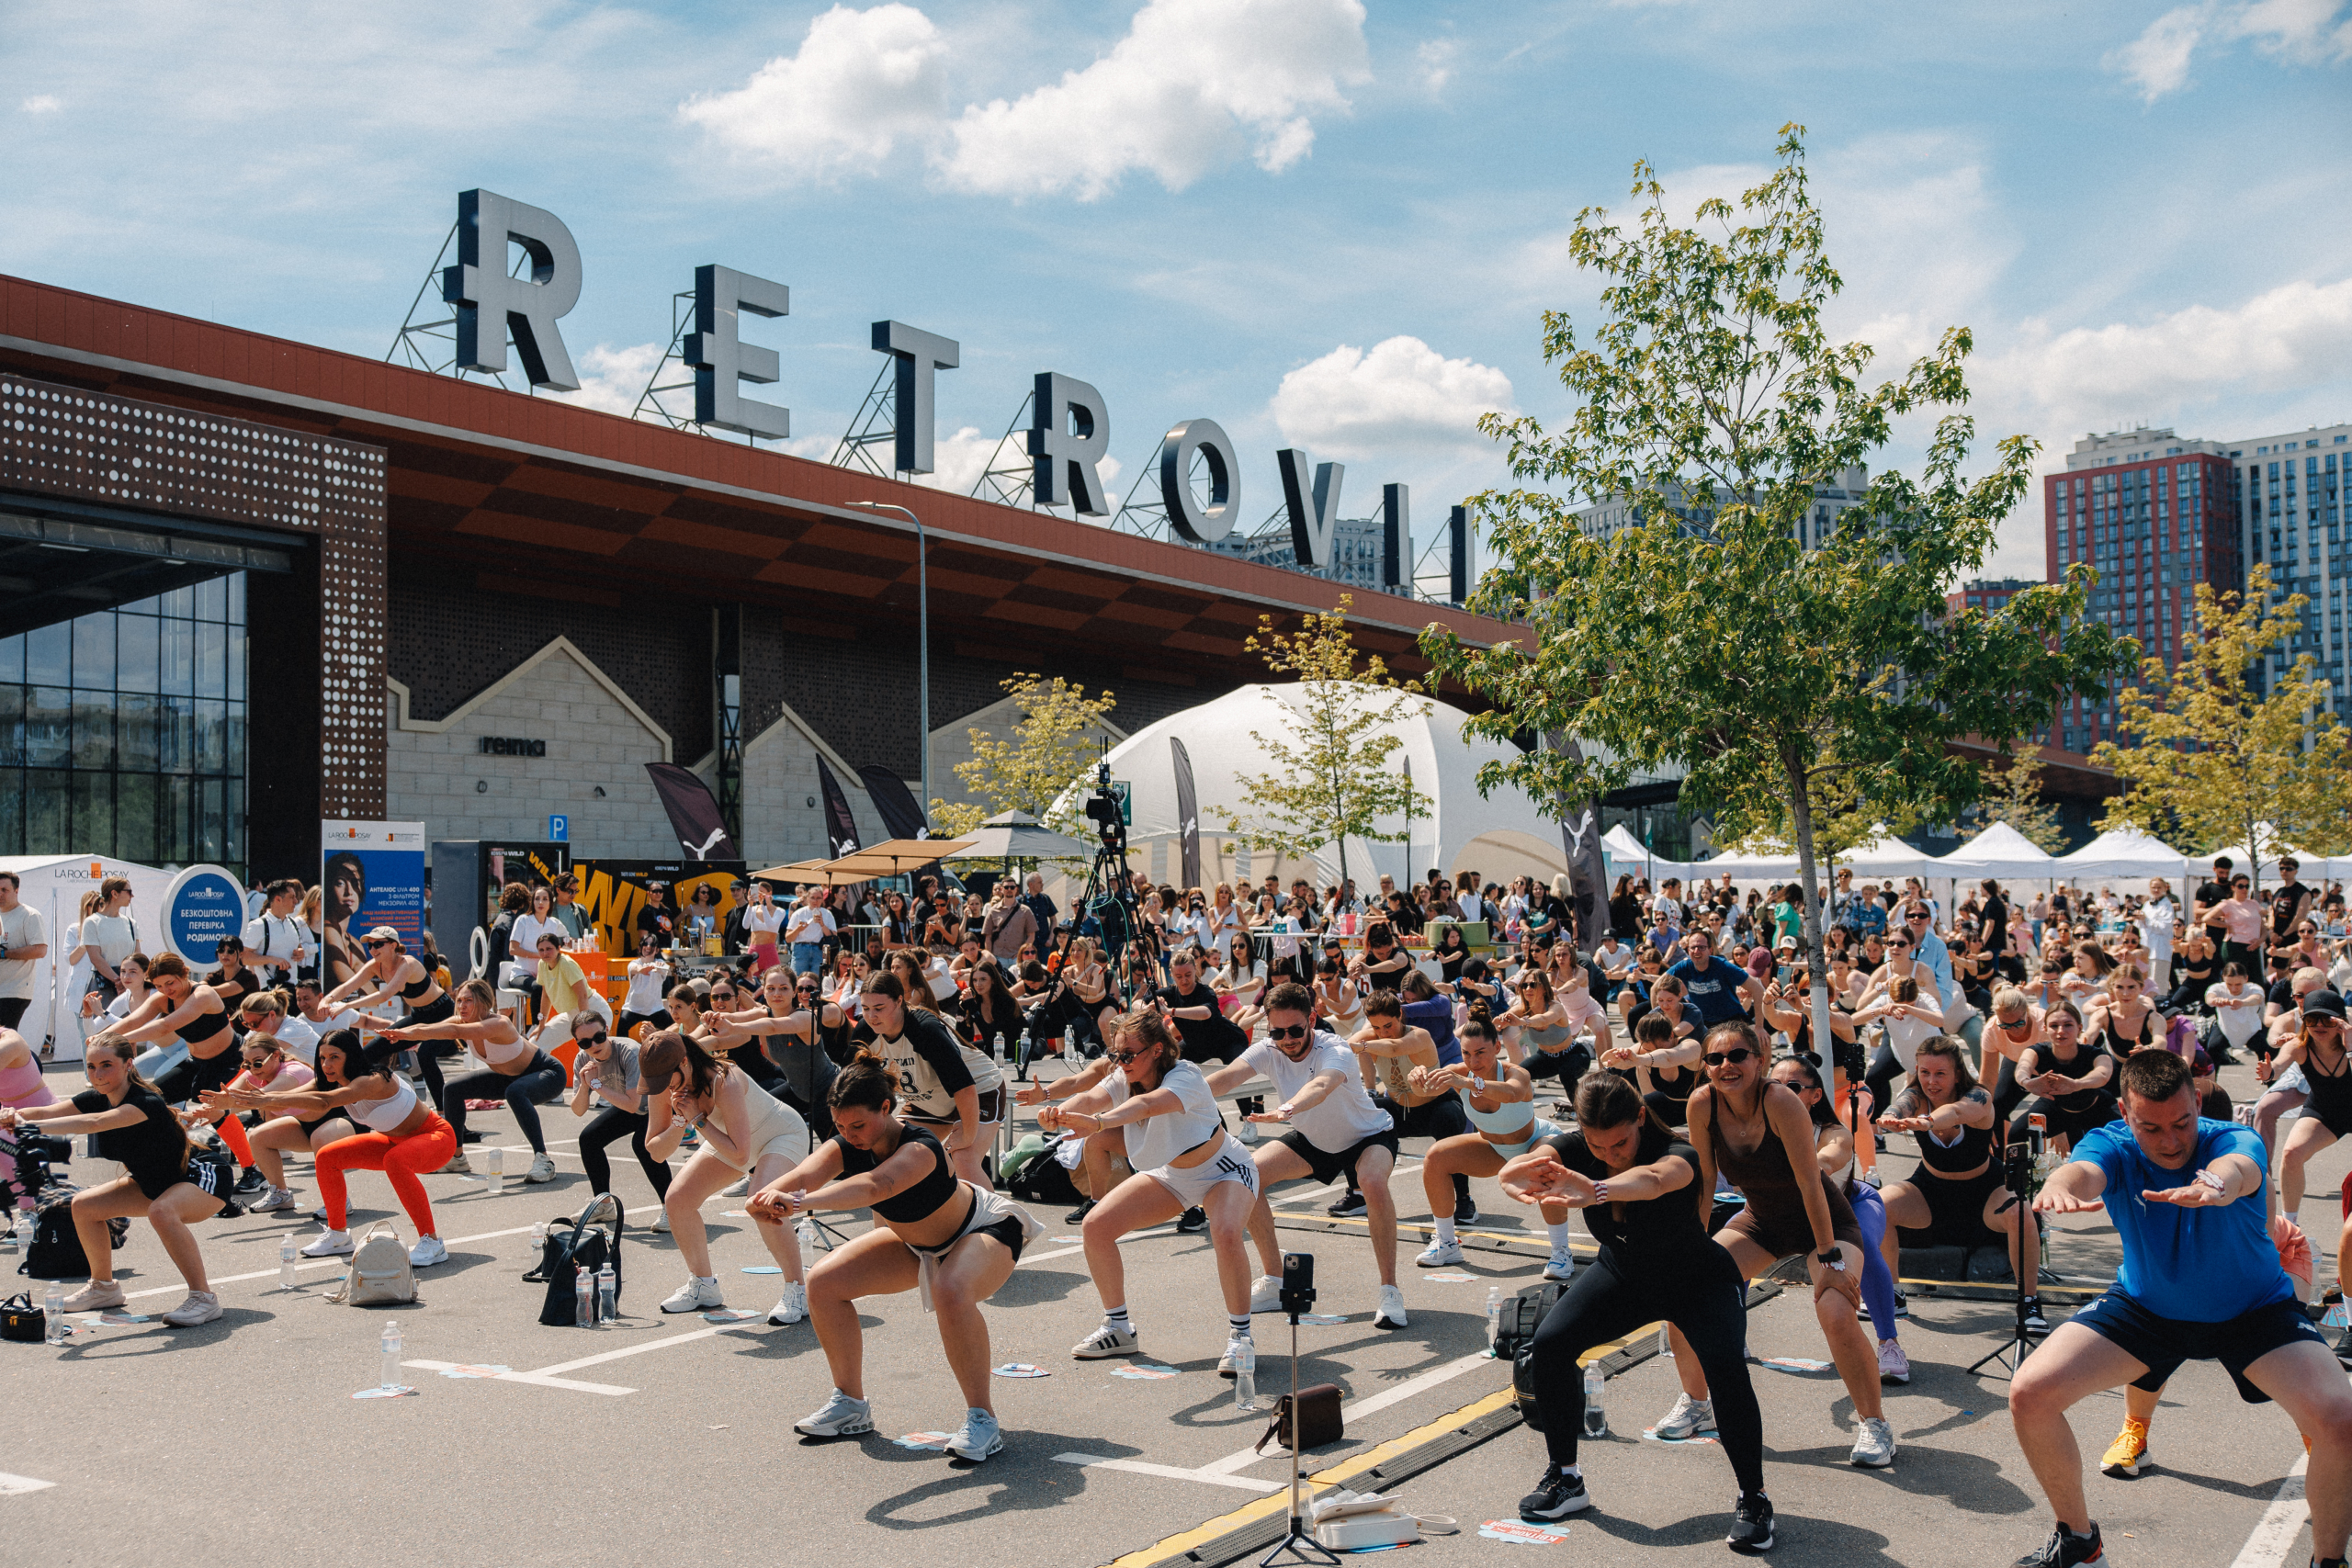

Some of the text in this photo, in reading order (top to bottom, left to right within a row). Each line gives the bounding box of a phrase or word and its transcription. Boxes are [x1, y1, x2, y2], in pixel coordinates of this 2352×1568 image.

[553, 818, 564, 839] P
[180, 909, 233, 918] БЕЗКОШТОВНА
[188, 921, 225, 930] ПЕРЕВІРКА
[1508, 1529, 1559, 1543] КВІТКОВЕ
